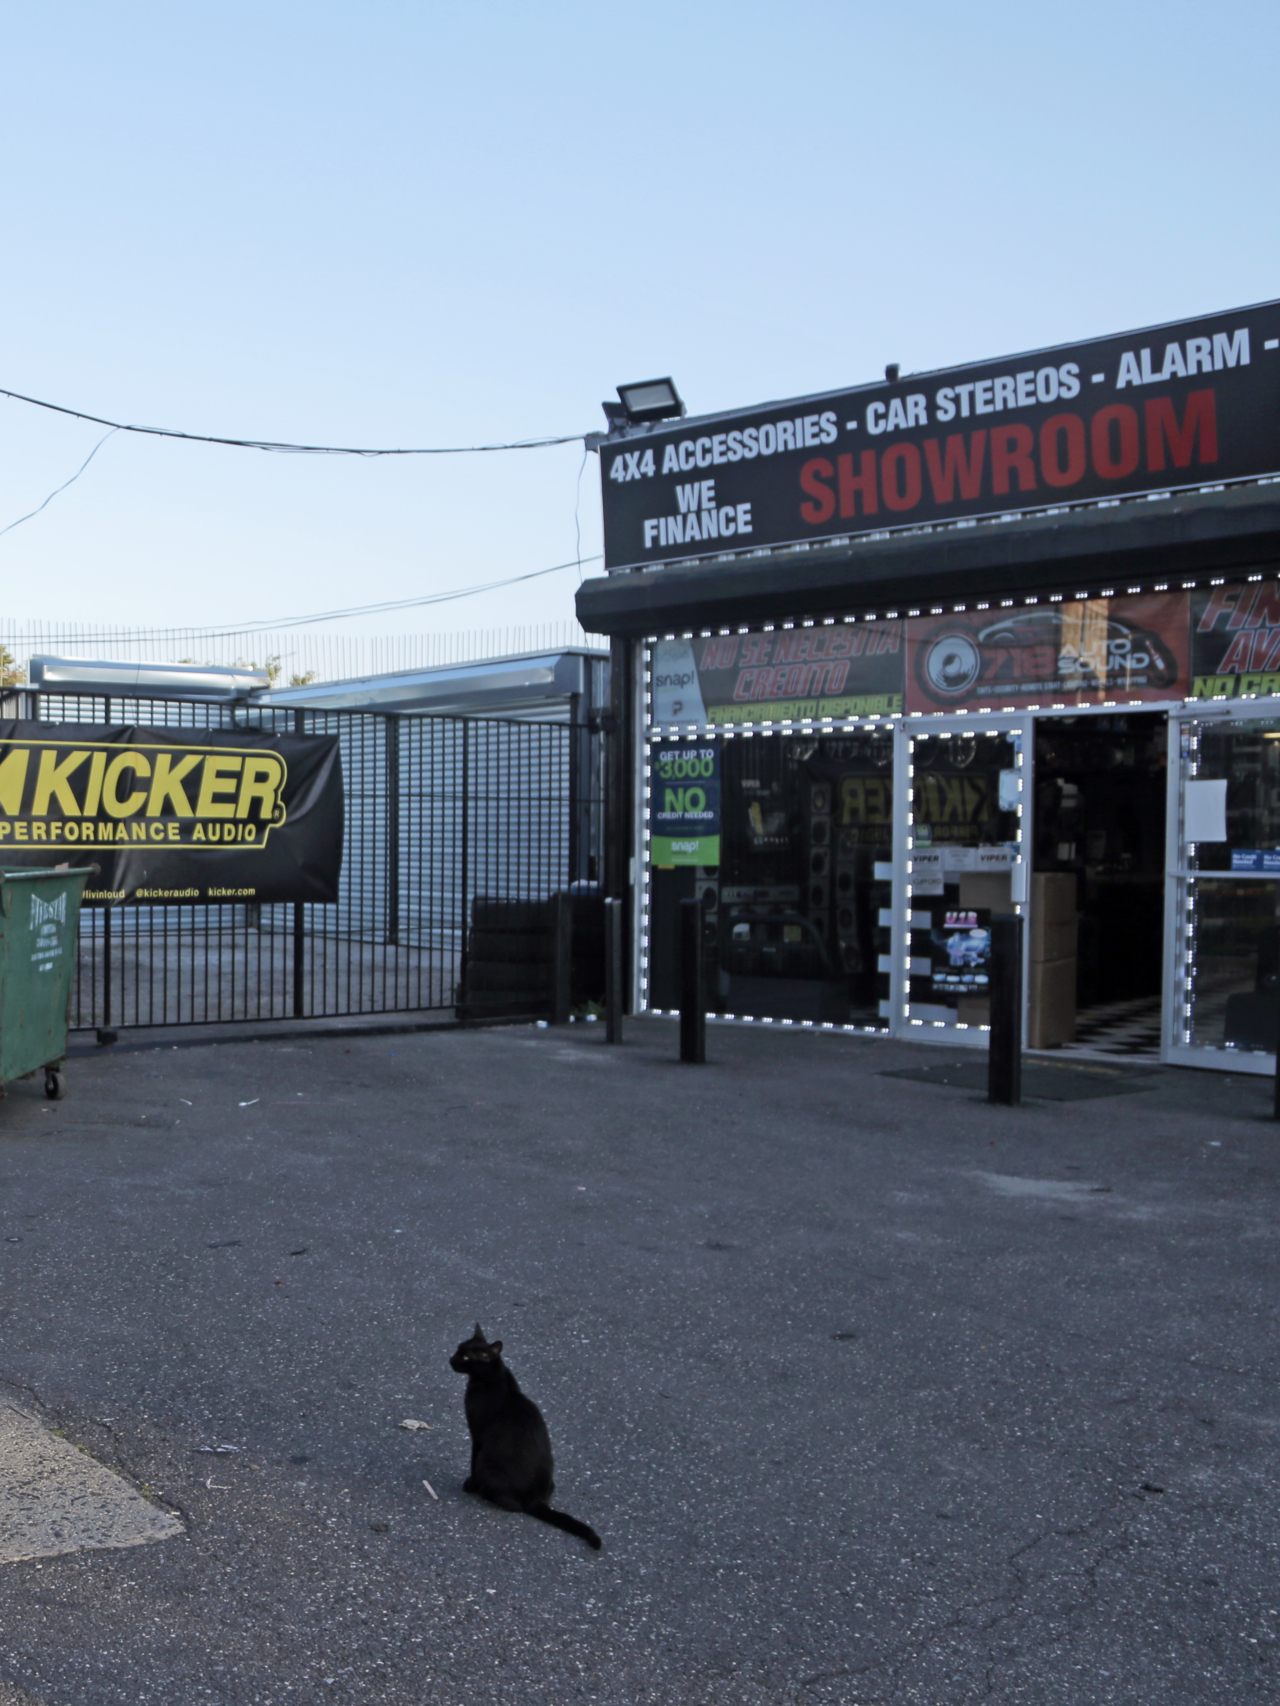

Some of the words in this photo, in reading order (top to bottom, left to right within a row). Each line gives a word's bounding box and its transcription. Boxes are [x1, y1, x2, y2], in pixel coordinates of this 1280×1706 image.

[609, 449, 656, 483] 4X4
[661, 414, 839, 475] ACCESSORIES
[865, 391, 928, 436] CAR
[935, 363, 1081, 422] STEREOS
[1116, 327, 1251, 389] ALARM
[800, 388, 1218, 523] SHOWROOM
[676, 479, 717, 514] WE
[643, 503, 753, 548] FINANCE
[700, 636, 737, 671] NO
[739, 632, 774, 666] SE
[773, 620, 901, 662] NECESITA
[1058, 638, 1131, 659] AUTO
[982, 644, 1056, 679] 718
[1057, 653, 1150, 675] SOUND
[656, 670, 695, 689] snap!
[733, 660, 851, 701] CREDITO
[1192, 676, 1237, 699] NO
[820, 694, 903, 715] DISPONIBLE
[660, 751, 681, 760] GET
[682, 750, 697, 760] UP
[699, 749, 714, 759] TO
[655, 757, 714, 780] $3,000
[31, 749, 283, 819] KICKER
[665, 786, 706, 813] NO
[657, 811, 683, 820] CREDIT
[684, 811, 714, 819] NEEDED
[192, 823, 256, 842] AUDIO
[671, 840, 699, 853] snap!
[913, 855, 939, 863] VIPER
[981, 854, 1008, 862] VIPER
[135, 887, 199, 898] @kickeraudio
[208, 887, 256, 897] kicker.com
